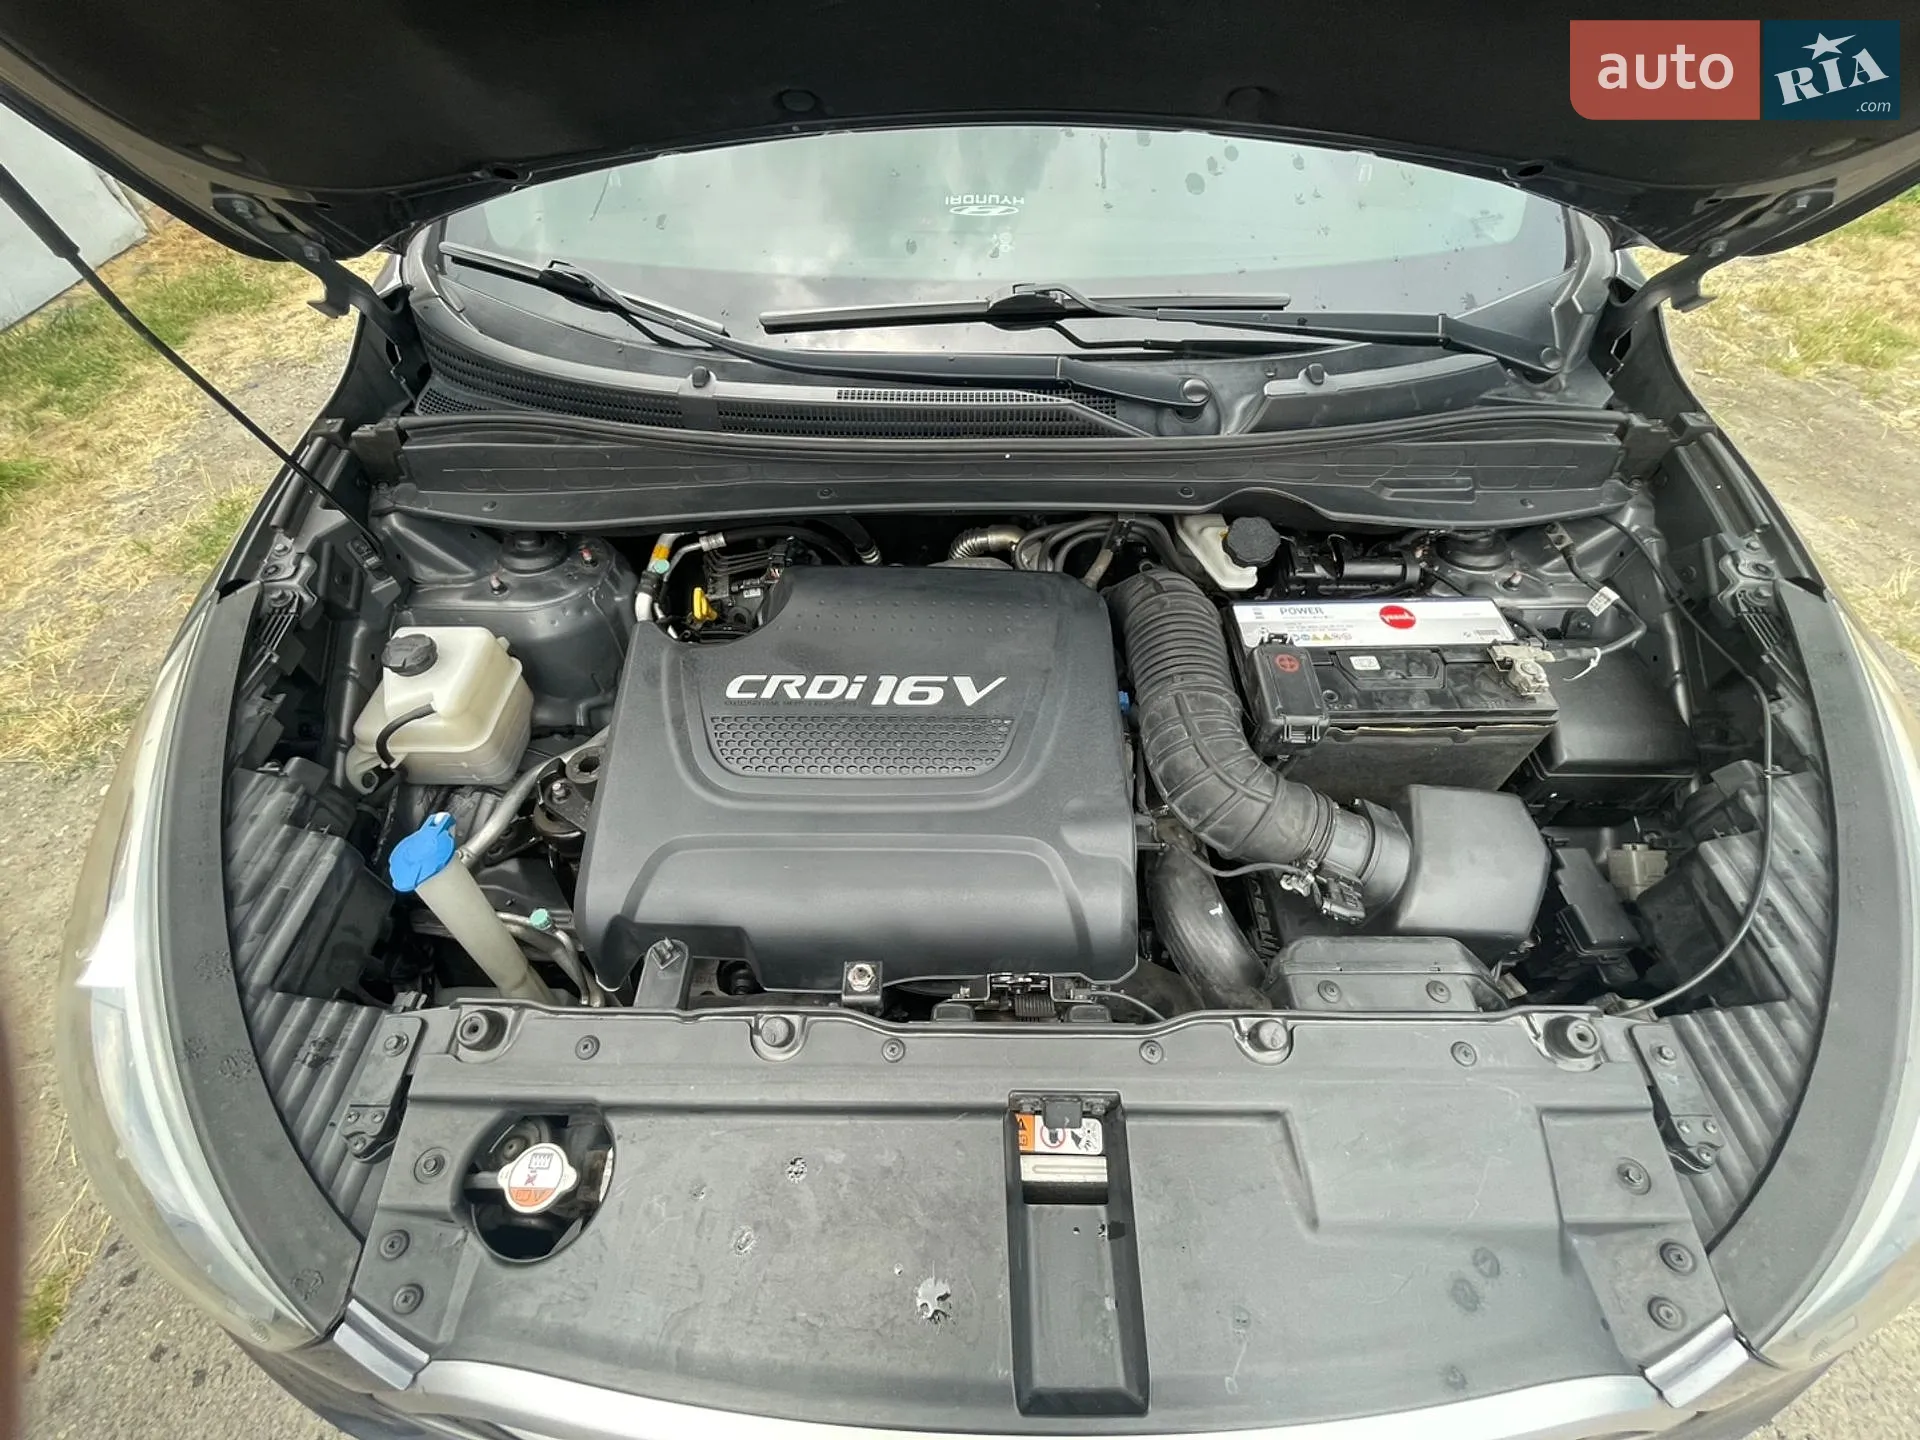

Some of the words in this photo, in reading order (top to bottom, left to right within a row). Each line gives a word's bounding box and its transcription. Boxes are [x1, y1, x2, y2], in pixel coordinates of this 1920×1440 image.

[945, 194, 1025, 205] HYUNDAI
[1279, 606, 1325, 616] POWER
[725, 674, 868, 701] CRDi
[871, 675, 1007, 707] 16V
